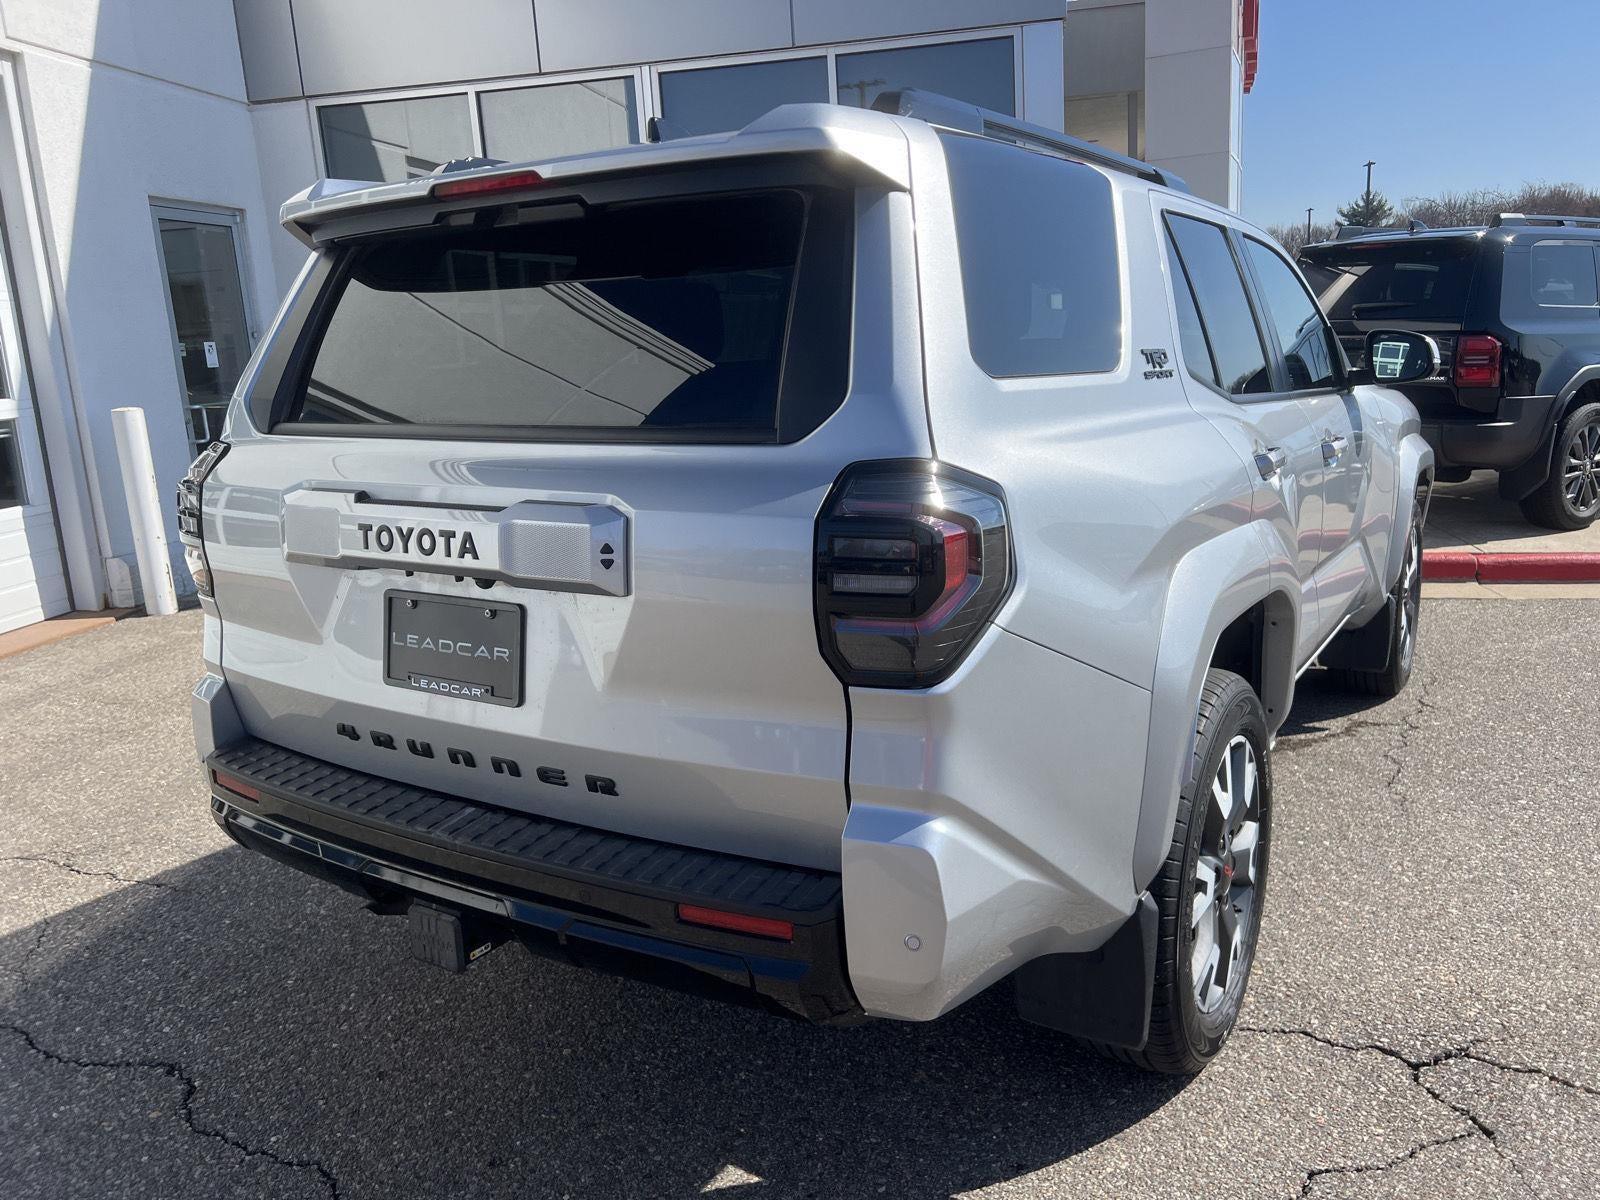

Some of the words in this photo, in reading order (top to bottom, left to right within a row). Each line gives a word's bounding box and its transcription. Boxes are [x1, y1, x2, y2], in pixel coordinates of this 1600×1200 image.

[1140, 348, 1169, 369] TRD
[1143, 370, 1174, 380] SPORT
[357, 522, 480, 560] TOYOTA
[392, 631, 510, 662] LEADCAR
[411, 677, 482, 697] LEADCAR
[336, 722, 619, 796] 4RUNNER
